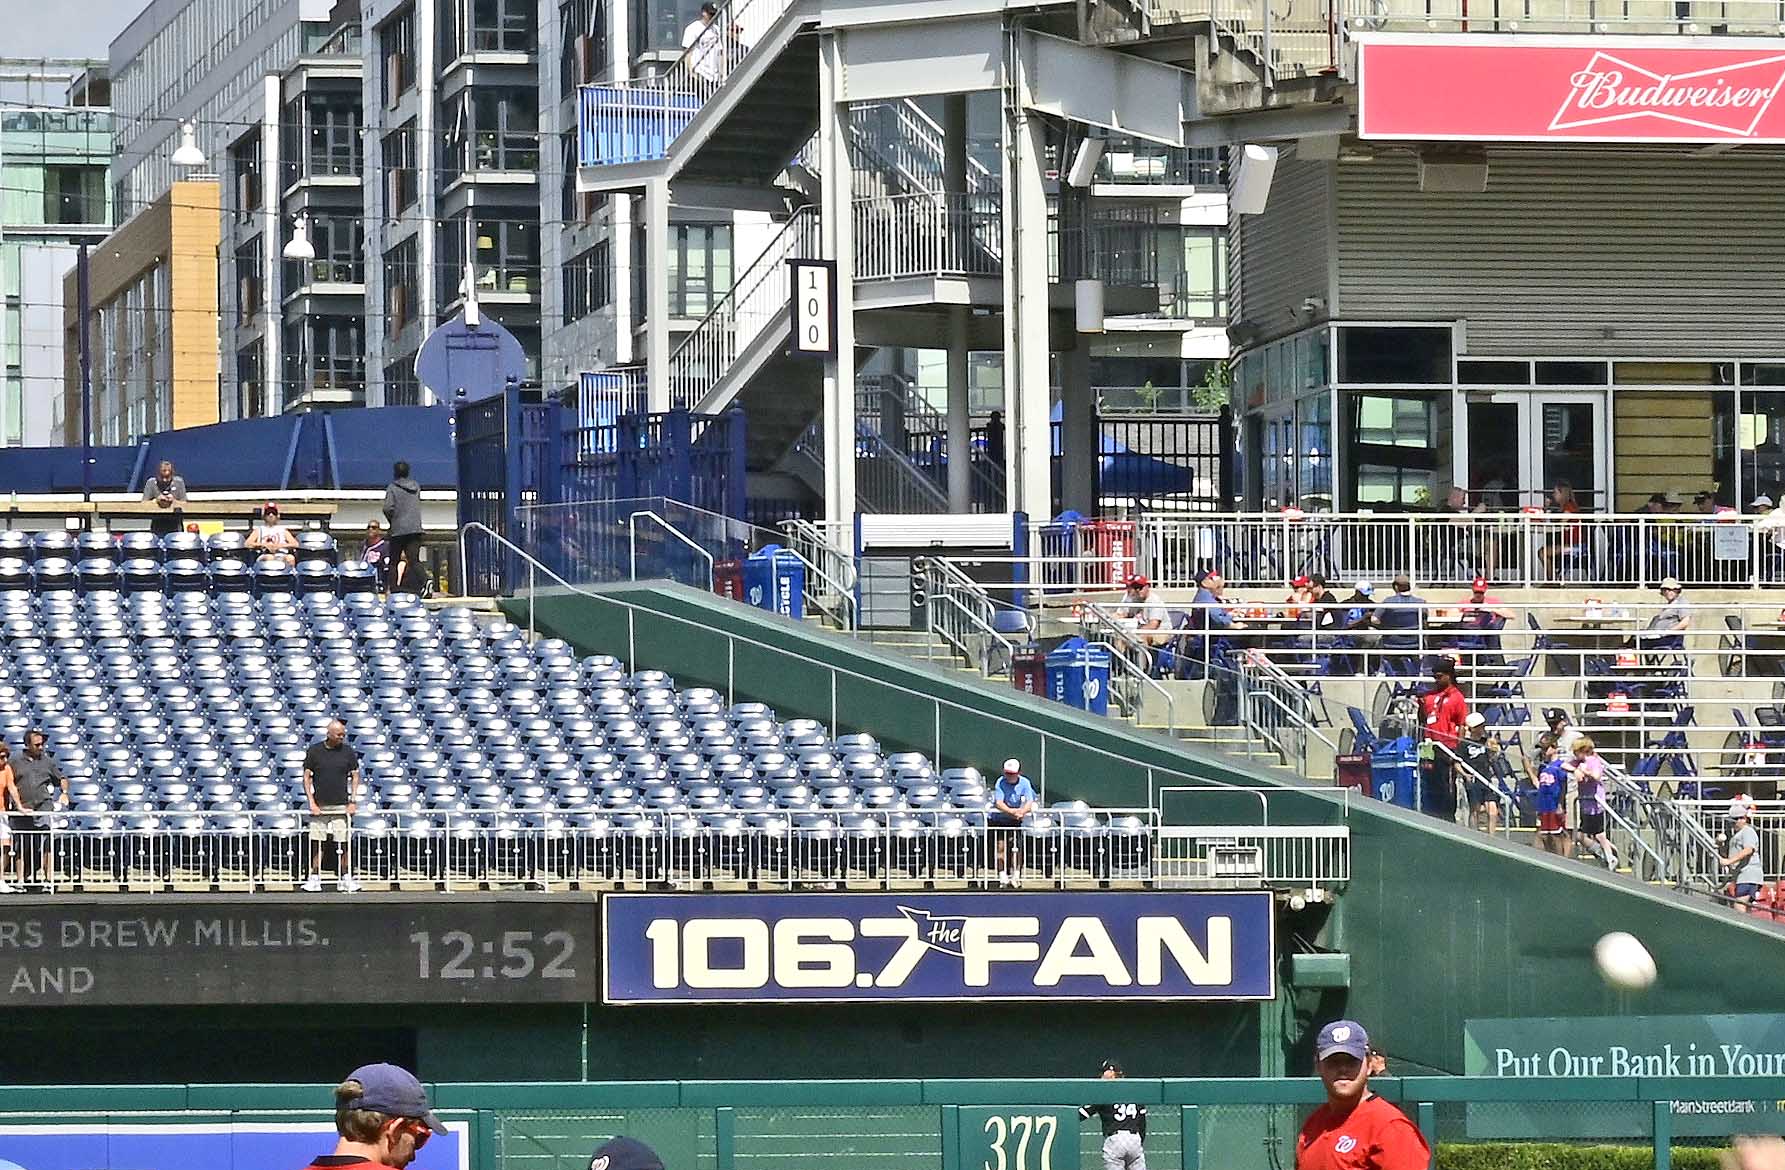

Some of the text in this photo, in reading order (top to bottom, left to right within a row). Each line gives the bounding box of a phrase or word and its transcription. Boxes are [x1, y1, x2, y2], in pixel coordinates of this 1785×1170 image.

[1569, 57, 1774, 112] Budweiser
[60, 919, 179, 948] DREW
[194, 919, 330, 947] MILLIS.
[408, 930, 577, 980] 12:52
[645, 915, 1233, 989] 106.7 the FAN
[9, 966, 95, 994] AND
[1496, 1048, 1541, 1076] Put
[1548, 1047, 1604, 1076] Our
[1609, 1045, 1681, 1076] Bank
[1688, 1043, 1716, 1076] in
[1113, 1103, 1138, 1122] 34
